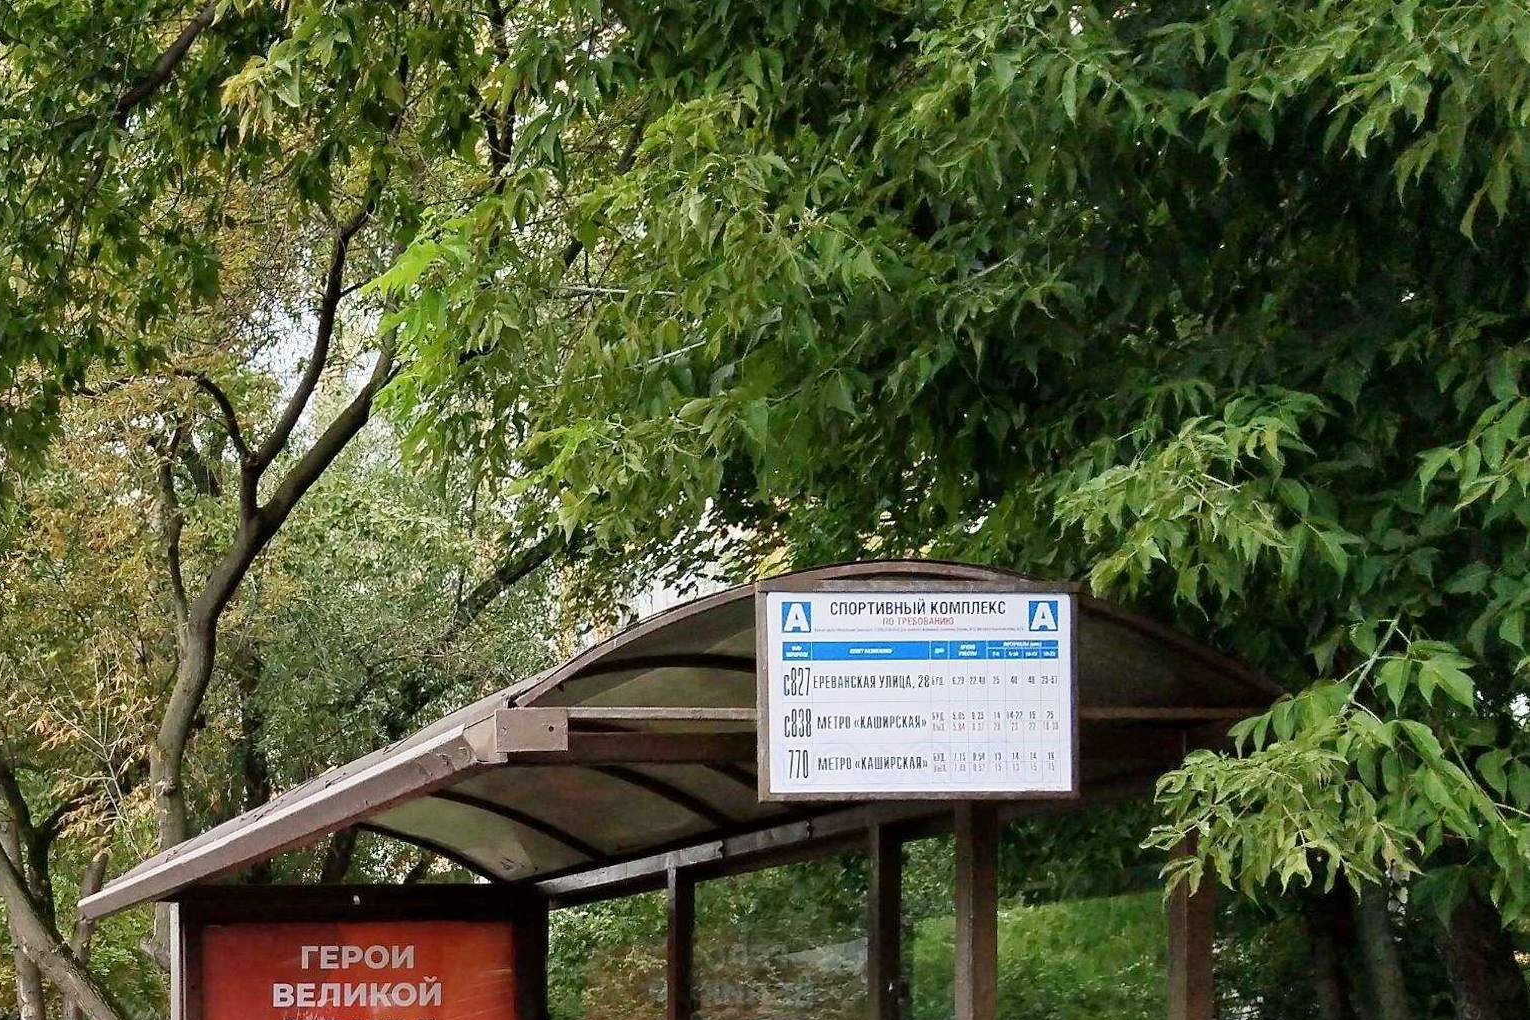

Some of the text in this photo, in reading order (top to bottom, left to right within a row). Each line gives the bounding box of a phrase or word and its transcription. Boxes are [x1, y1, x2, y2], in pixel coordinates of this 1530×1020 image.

[830, 598, 1006, 615] СПОРТИВНЫЙ КОМПЛЕКС
[882, 617, 955, 626] ПО ТРЕБОВАНИЮ
[783, 667, 930, 696] с827 ЕРЕВАНСКАЯ УЛИЦА, 28
[784, 708, 927, 738] с838 МЕТРО «КАШИРСКАЯ»
[788, 749, 928, 779] 770 МЕТРО «КАШИРСКАЯ»
[301, 945, 415, 970] ГЕРОИ
[272, 975, 443, 1008] ВЕЛИКОЙ
